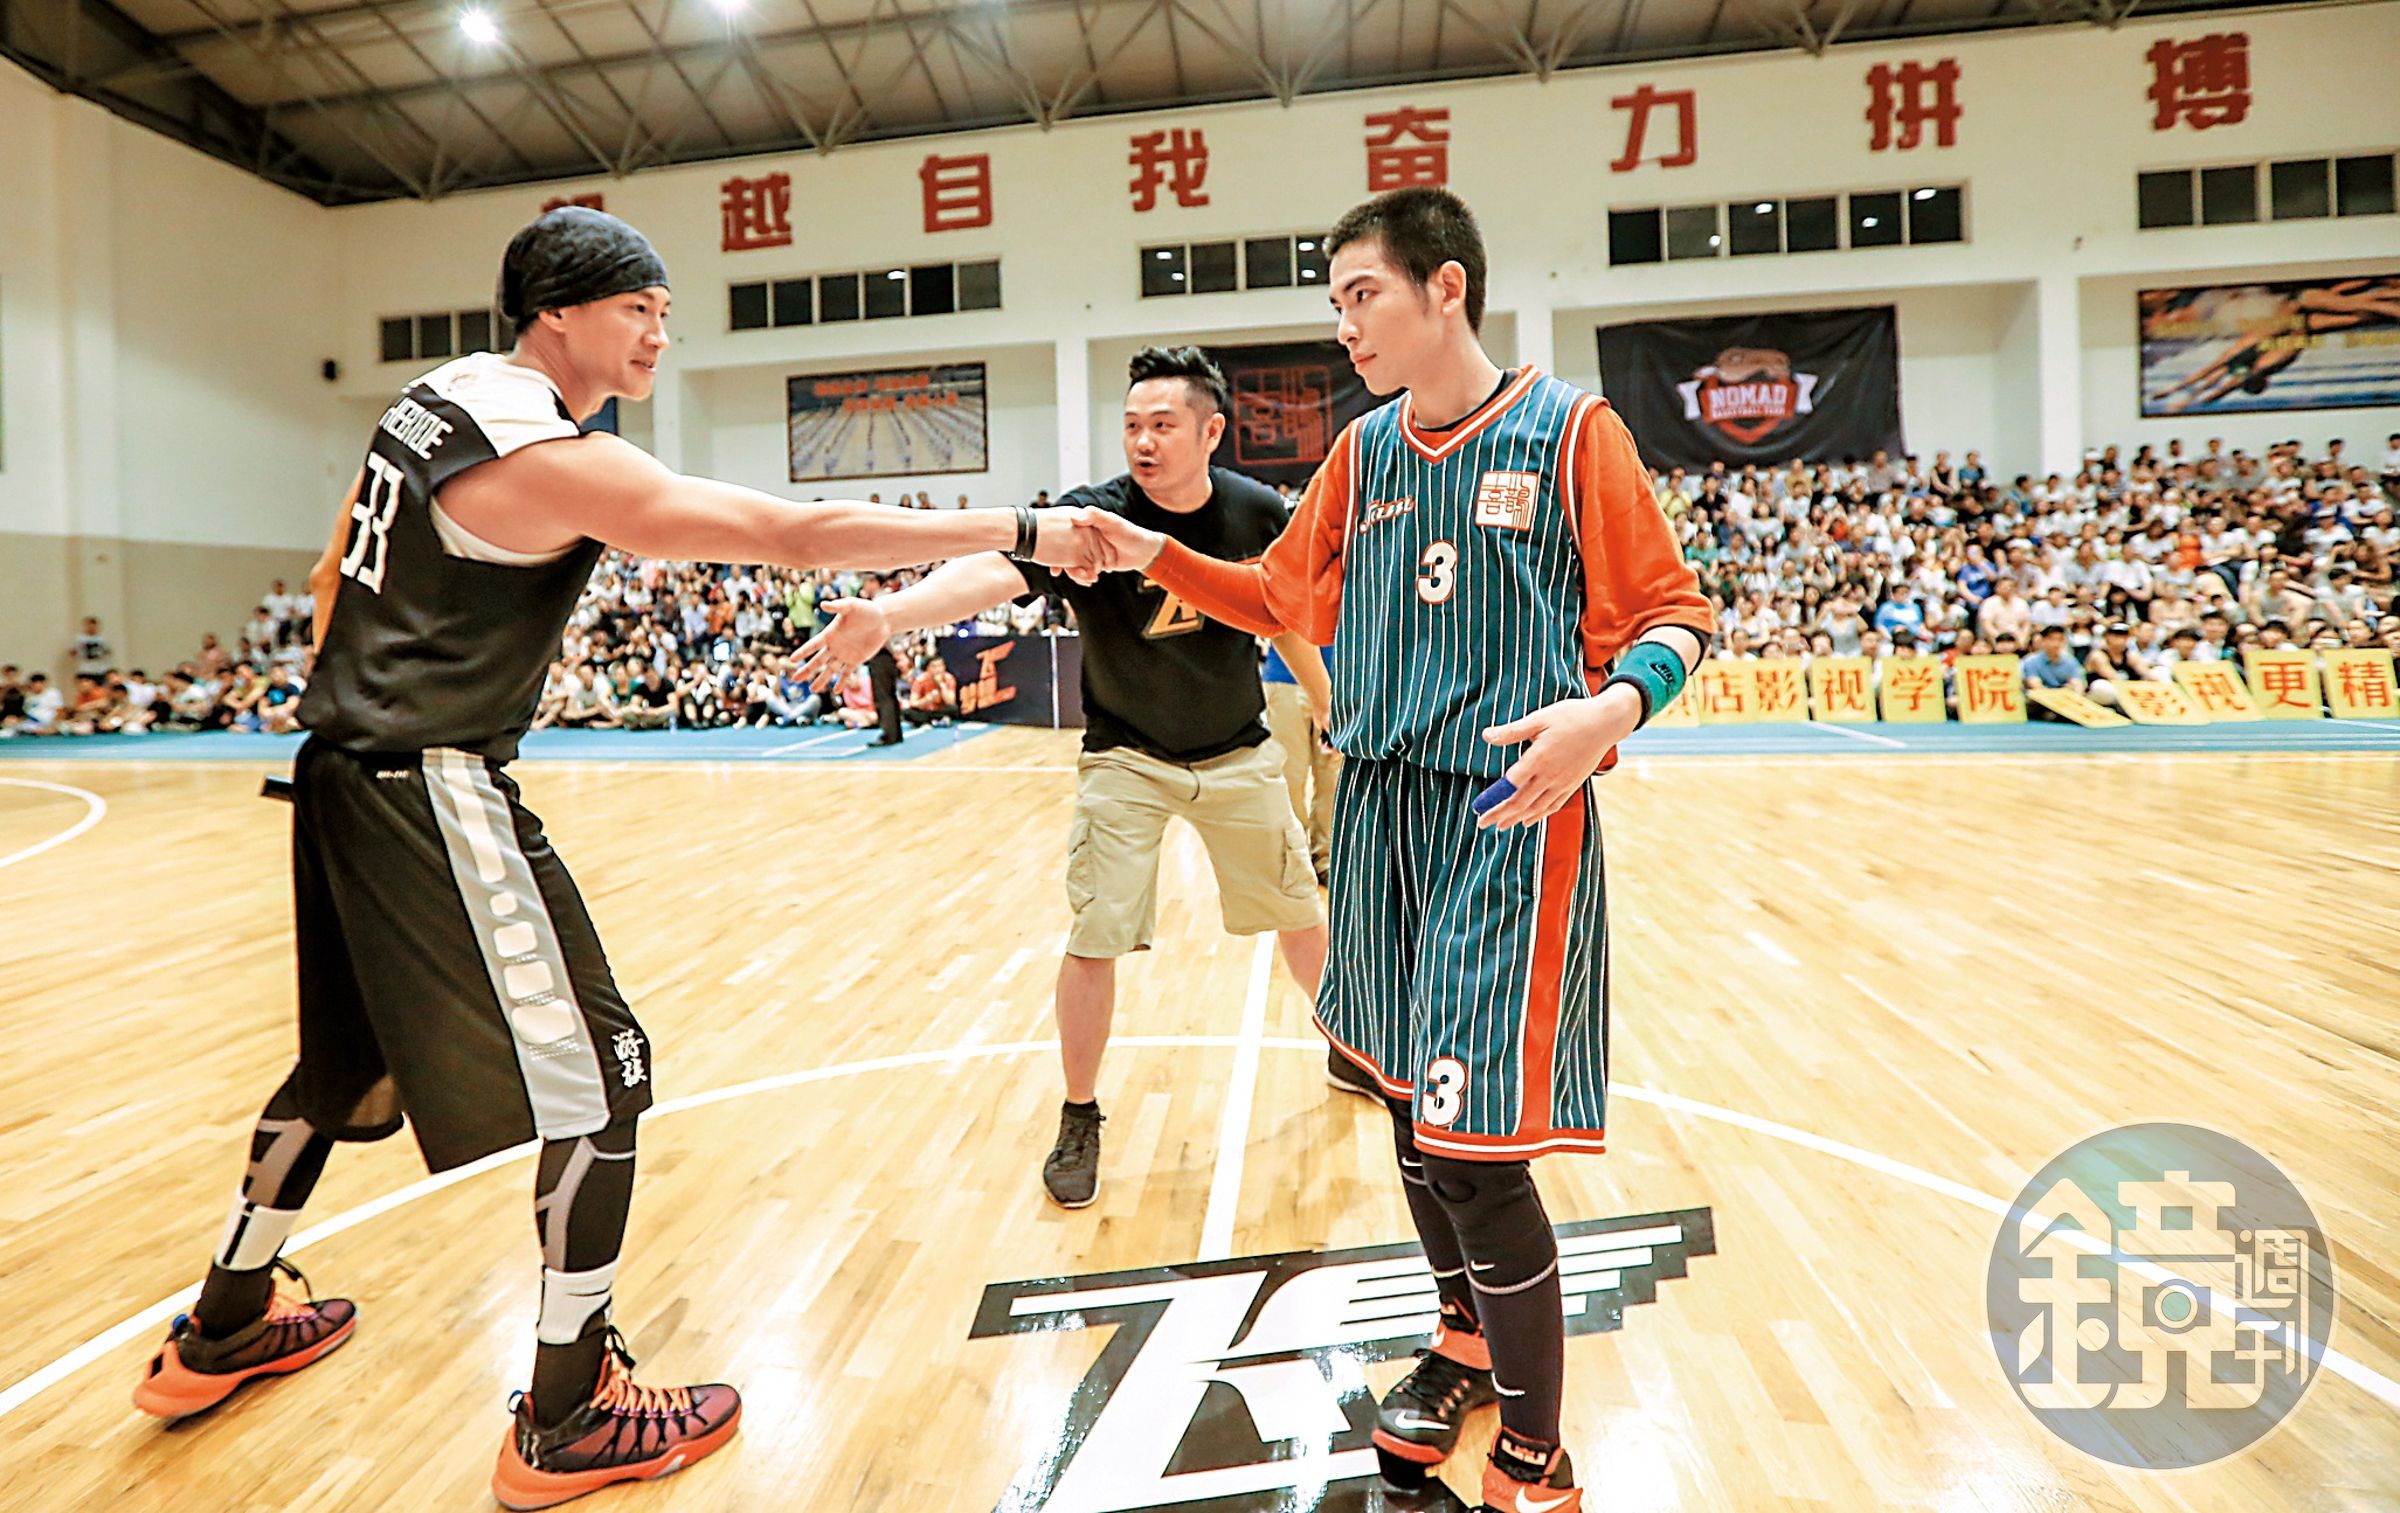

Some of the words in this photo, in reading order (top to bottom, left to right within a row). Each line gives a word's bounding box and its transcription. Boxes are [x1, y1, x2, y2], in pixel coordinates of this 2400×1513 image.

[1709, 384, 1788, 410] NOMAD
[339, 451, 405, 595] 33
[1416, 539, 1459, 605] 3
[1422, 1056, 1468, 1127] 3
